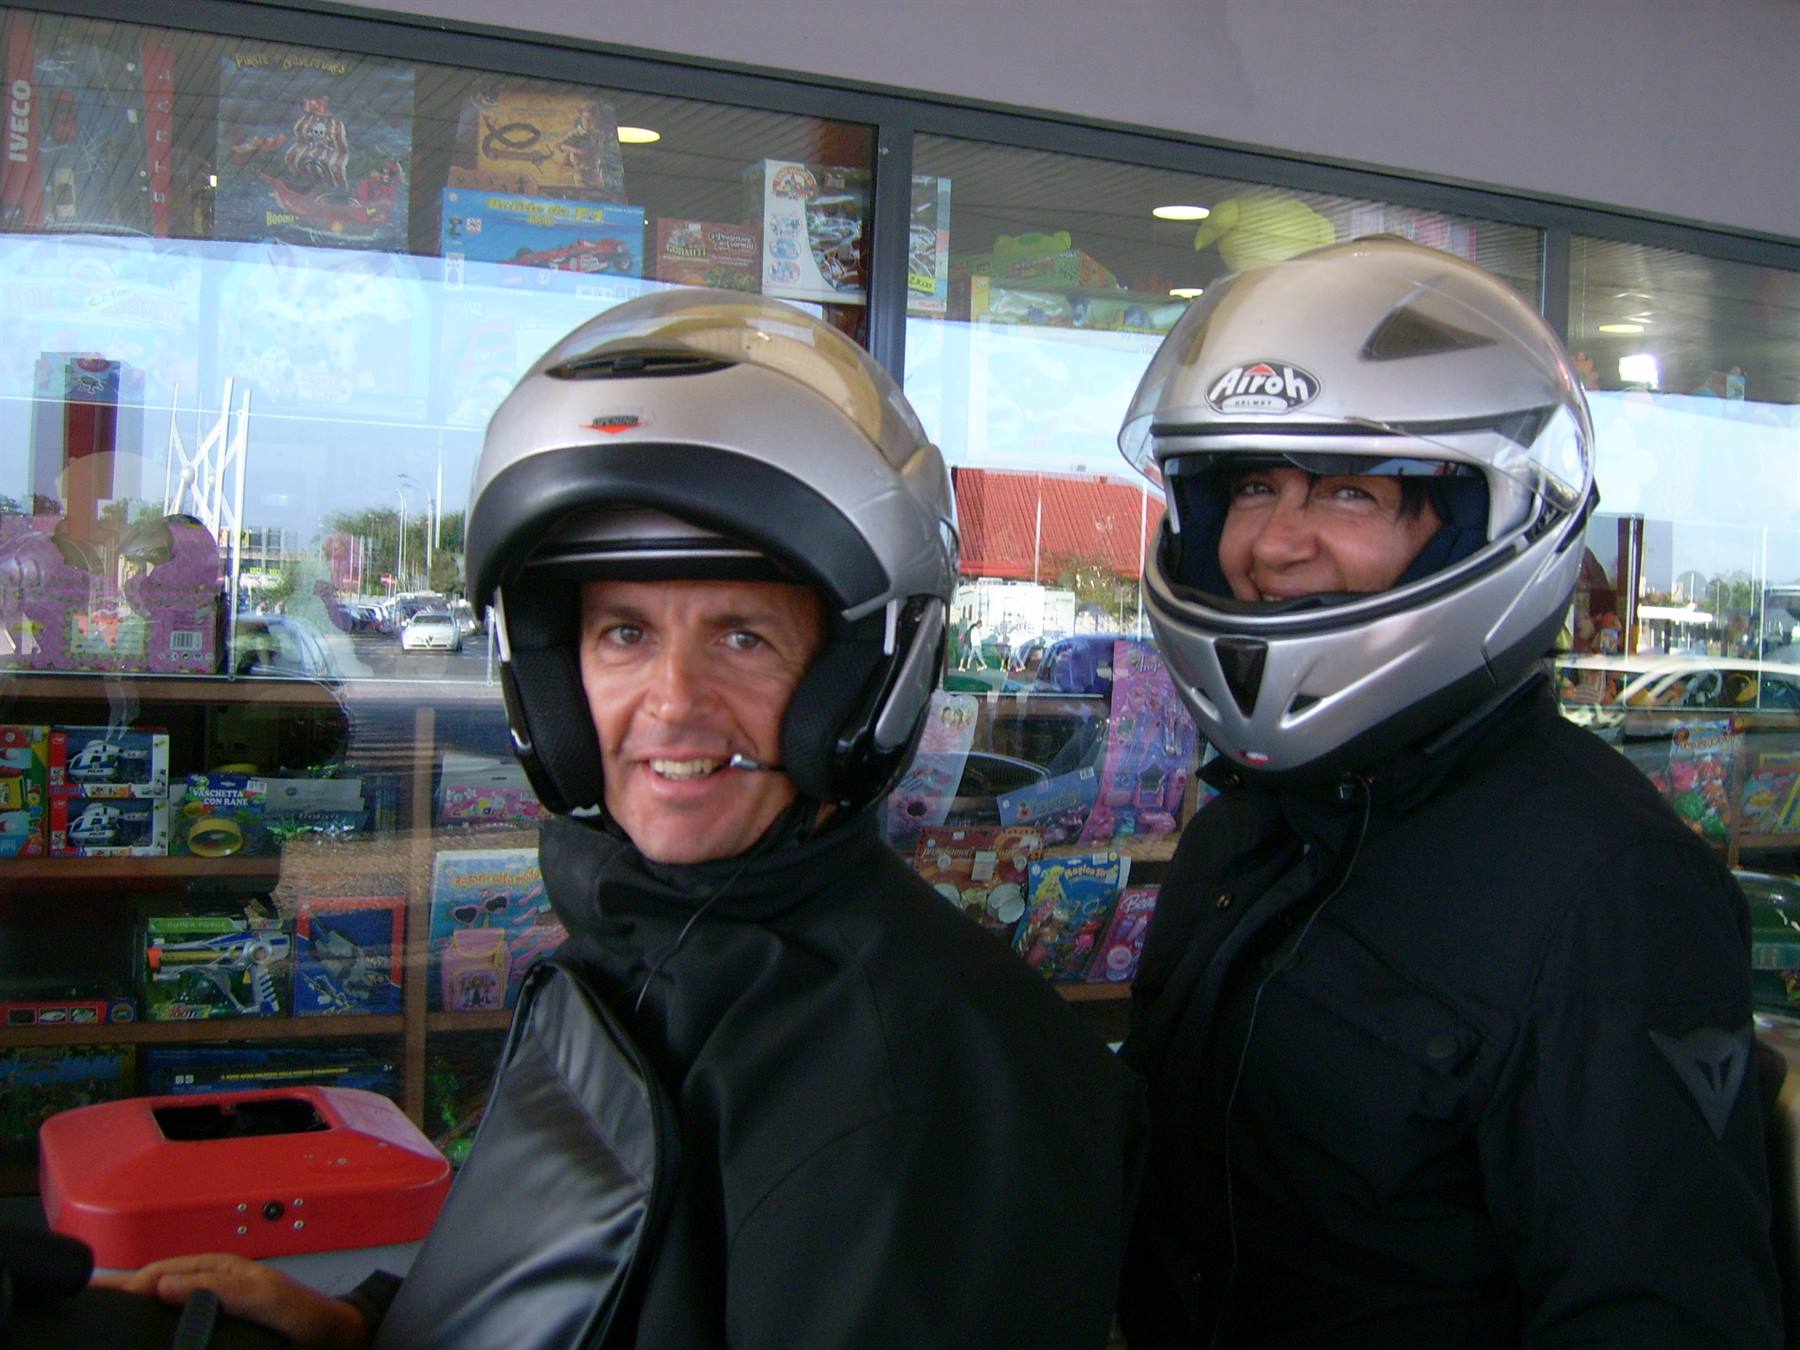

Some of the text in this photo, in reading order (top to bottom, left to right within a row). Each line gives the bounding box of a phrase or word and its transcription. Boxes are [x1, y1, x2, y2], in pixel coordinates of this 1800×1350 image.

[9, 79, 33, 163] IVECO
[666, 243, 707, 257] GORMITI
[1208, 367, 1310, 402] Airoh
[193, 788, 245, 798] VASCHETTA
[203, 798, 249, 806] CON RANE
